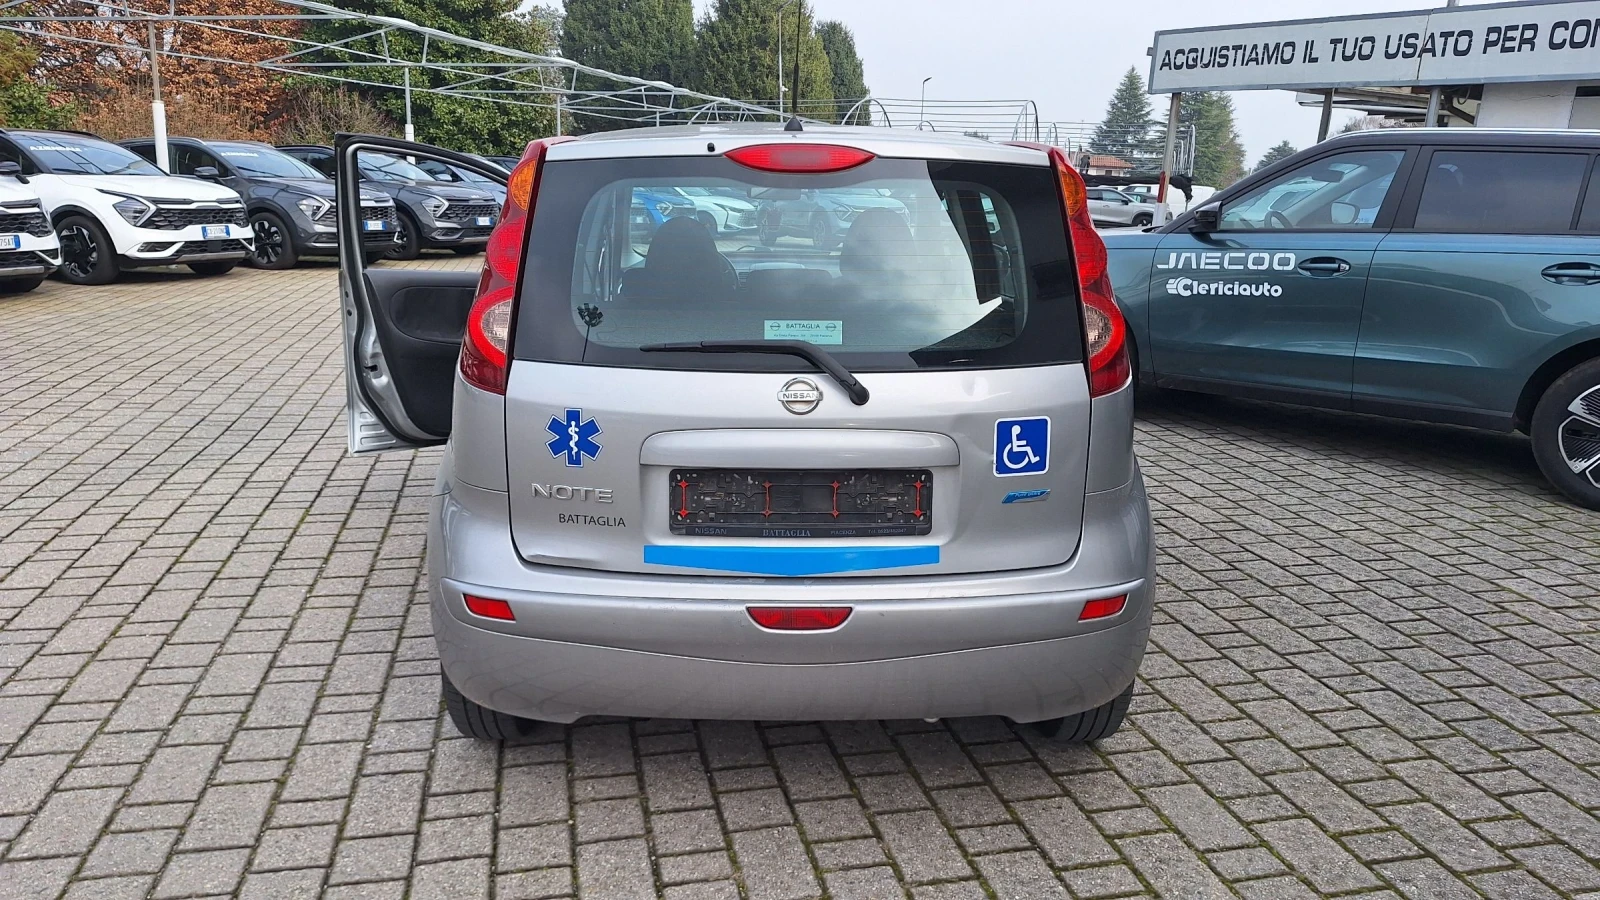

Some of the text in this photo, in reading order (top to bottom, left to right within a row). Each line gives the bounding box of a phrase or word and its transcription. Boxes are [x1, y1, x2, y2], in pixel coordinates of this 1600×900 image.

[1159, 41, 1296, 71] ACQUISTIAMO
[1302, 38, 1319, 64] IL
[1329, 35, 1376, 62] TUO
[1385, 29, 1475, 60] USATO
[1482, 22, 1539, 55] PER
[1156, 252, 1296, 271] JAECOO
[1174, 277, 1283, 297] Clericiauto
[782, 392, 819, 400] NISSAN
[531, 482, 613, 503] NOTE
[558, 513, 626, 528] BATTAGLIA
[695, 527, 727, 535] NISSAN
[762, 529, 811, 537] BATTAGLIA
